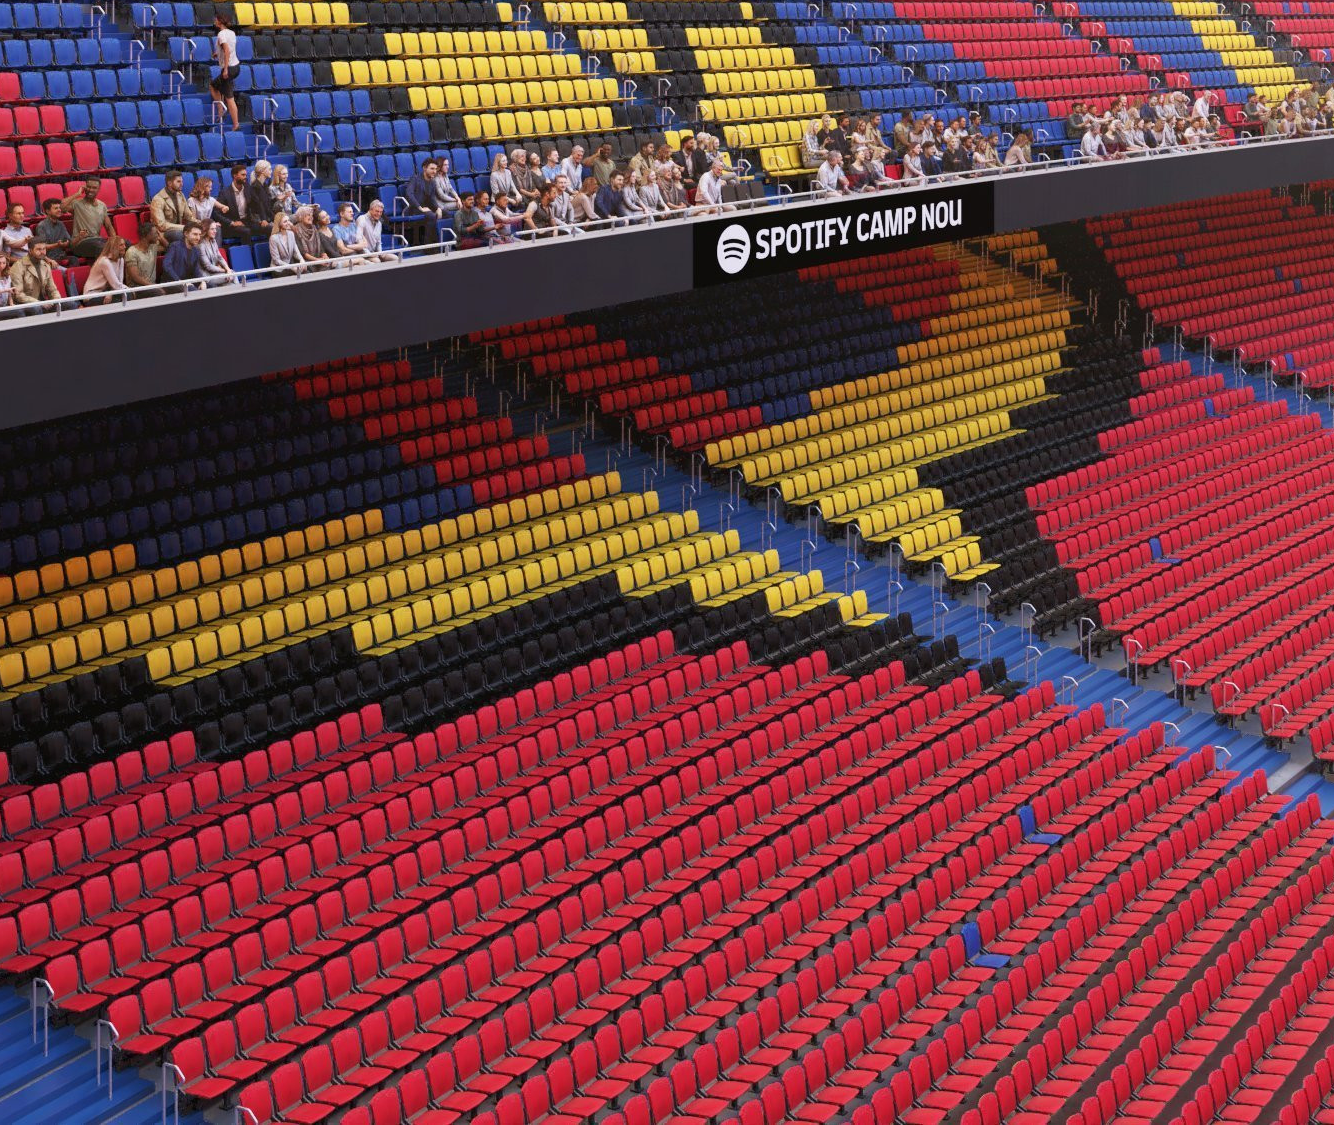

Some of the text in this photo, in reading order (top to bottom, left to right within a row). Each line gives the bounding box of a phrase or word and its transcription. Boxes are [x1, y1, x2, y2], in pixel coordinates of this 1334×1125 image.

[756, 198, 962, 260] SPOTIFY CAMP NOU
